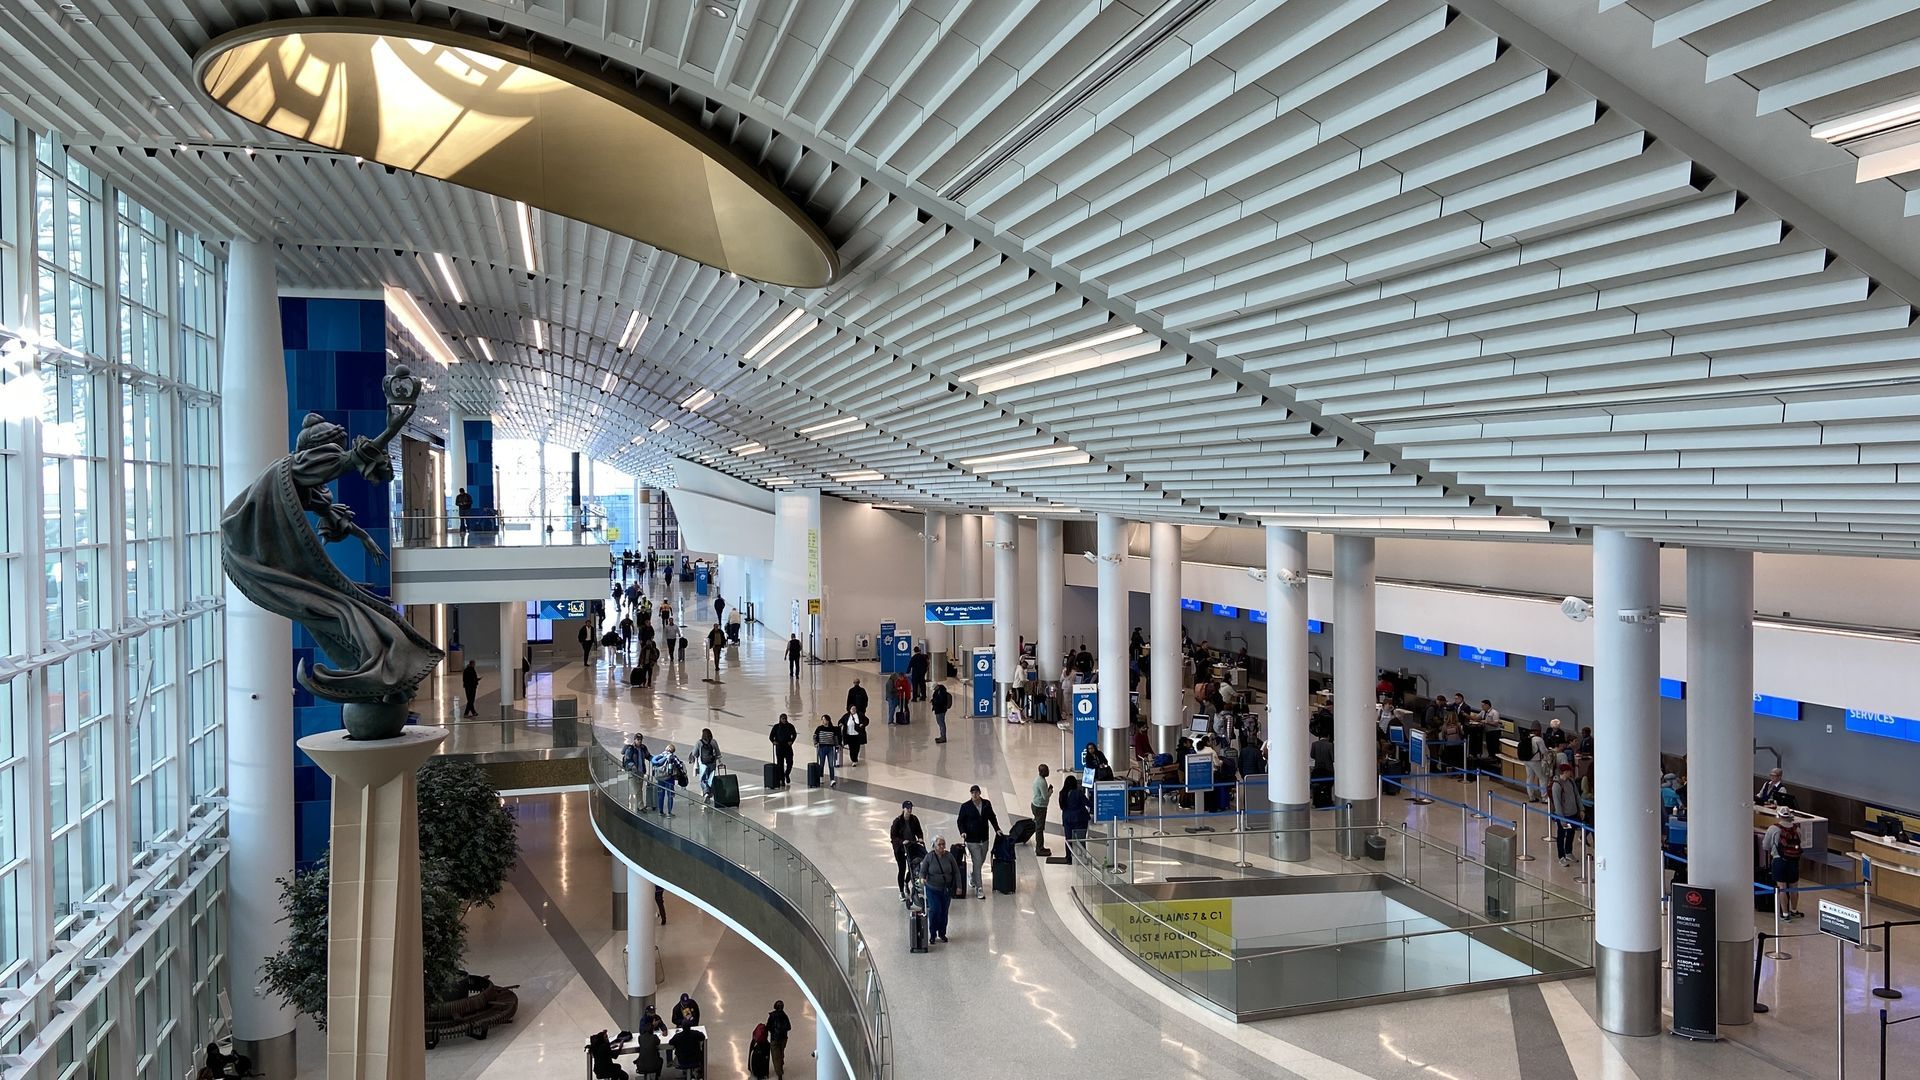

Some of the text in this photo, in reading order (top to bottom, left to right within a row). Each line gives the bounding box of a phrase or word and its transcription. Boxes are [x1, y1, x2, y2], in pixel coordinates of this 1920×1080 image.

[980, 661, 986, 669] 2
[1850, 709, 1894, 723] SERVICES
[1129, 914, 1151, 924] BAG
[1192, 912, 1198, 920] 7
[1200, 912, 1207, 920] &
[1210, 911, 1223, 920] C1
[1838, 909, 1858, 919] CANADA
[1130, 934, 1152, 942] LOST
